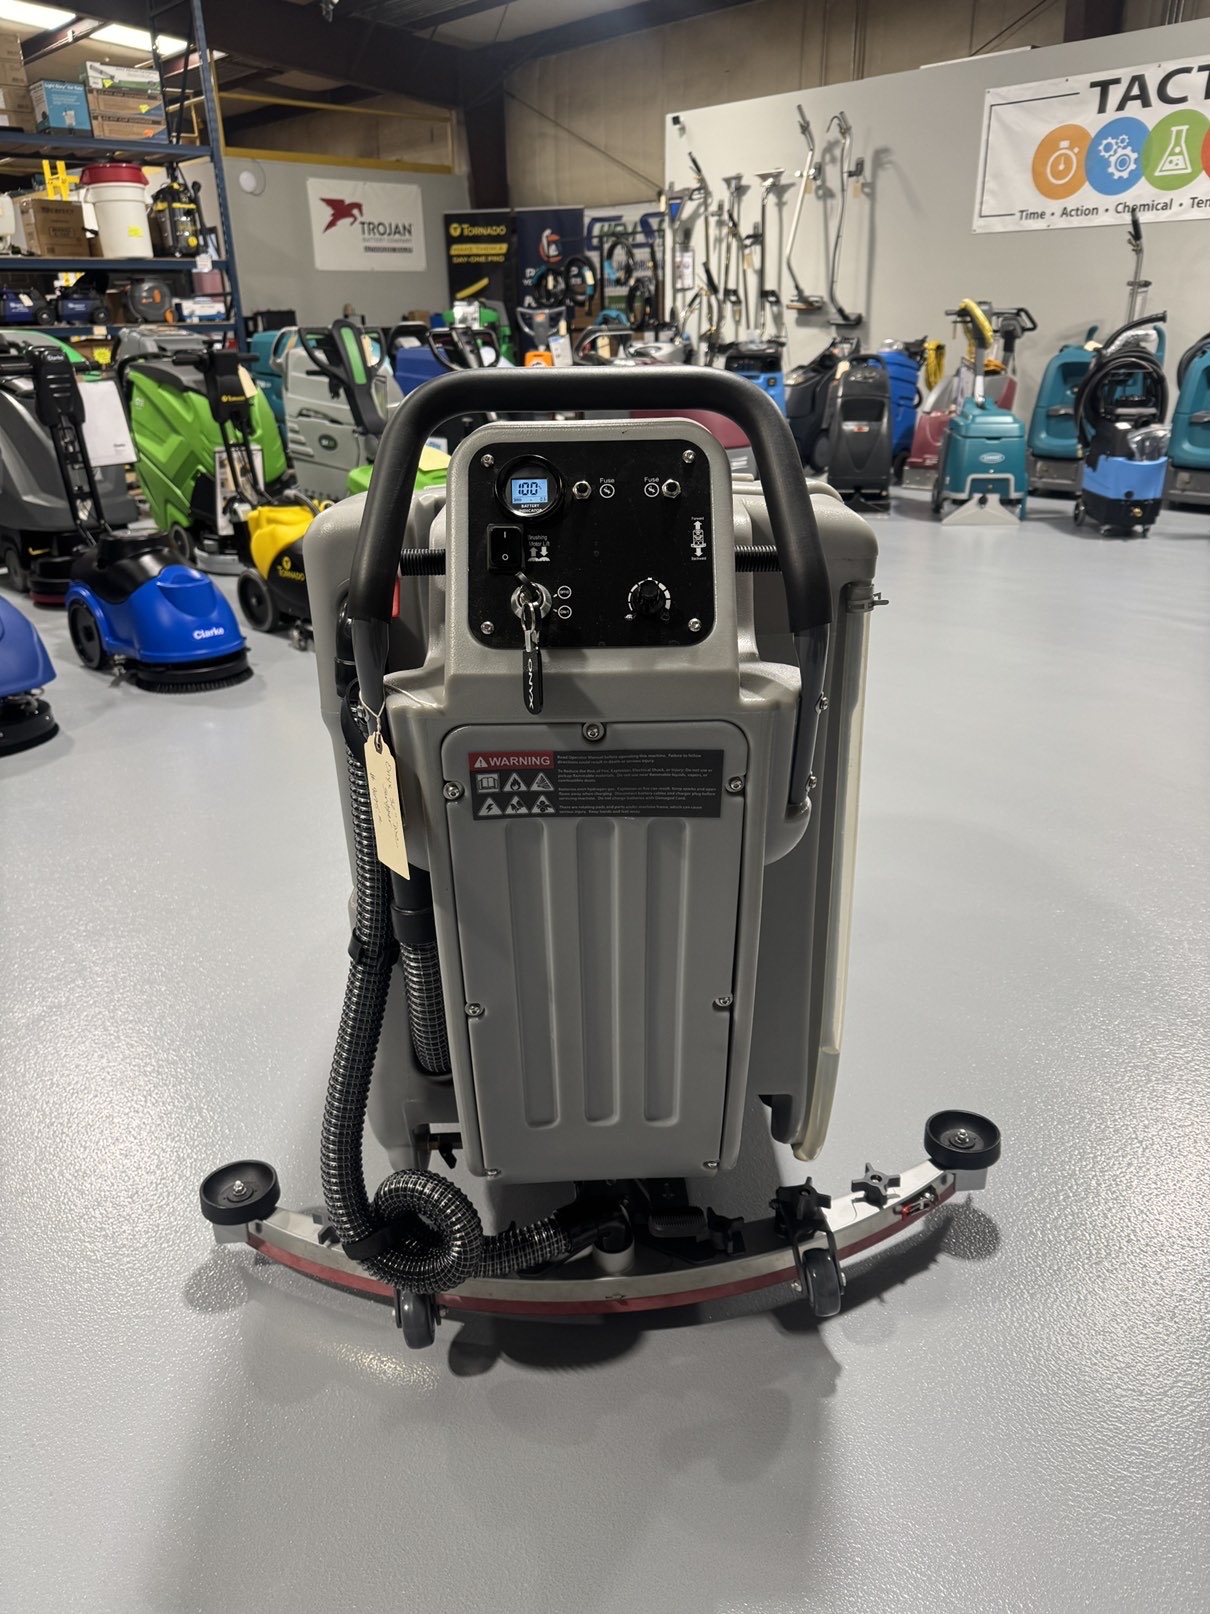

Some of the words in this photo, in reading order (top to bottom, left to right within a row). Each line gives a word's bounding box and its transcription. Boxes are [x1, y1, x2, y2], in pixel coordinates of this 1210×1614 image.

[1018, 208, 1046, 221] Time
[1060, 204, 1099, 218] Action
[1115, 198, 1173, 214] Chemical
[360, 222, 412, 236] TROJAN
[192, 627, 225, 640] Clarke
[489, 756, 550, 766] WARNING
